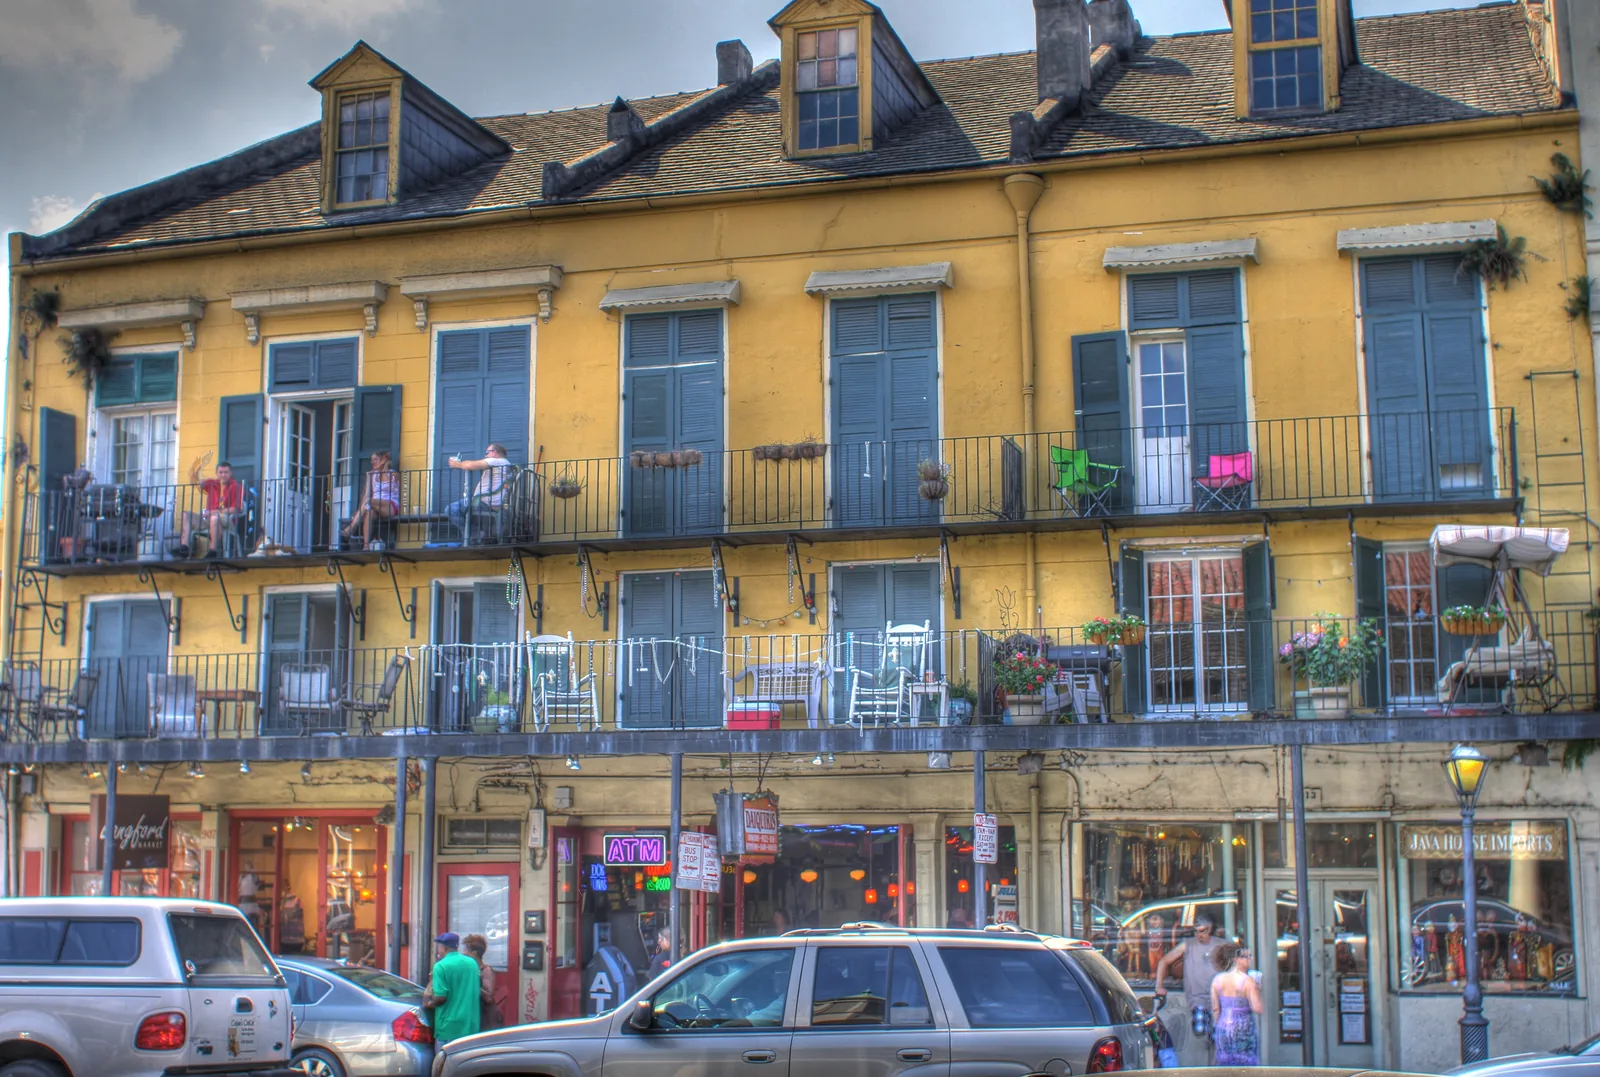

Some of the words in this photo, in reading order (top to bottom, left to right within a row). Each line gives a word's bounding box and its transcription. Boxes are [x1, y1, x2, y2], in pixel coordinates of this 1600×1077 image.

[100, 813, 168, 850] ngford
[607, 838, 661, 862] ATM
[684, 846, 697, 855] BUS
[1410, 834, 1440, 850] JAVA
[1444, 834, 1488, 851] HOSE
[1491, 834, 1553, 851] IMPORTS
[682, 855, 698, 863] STOP
